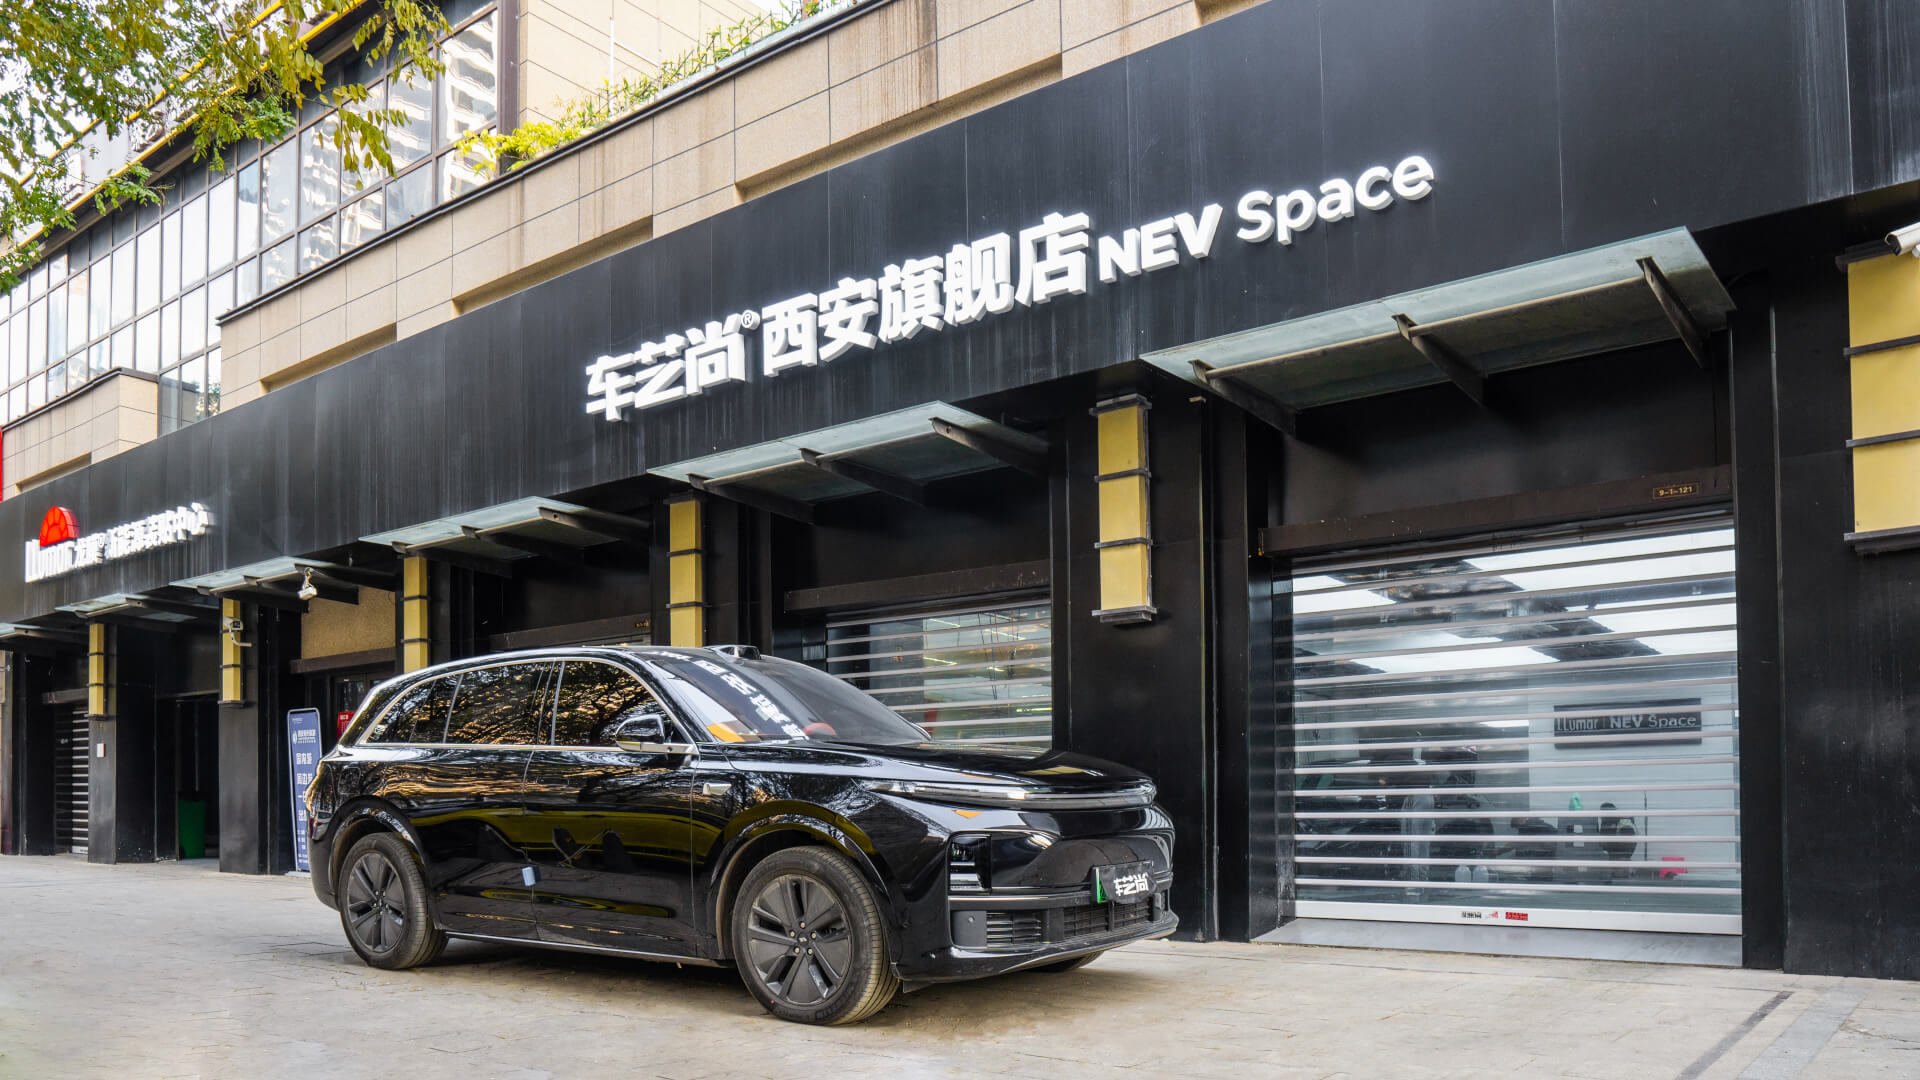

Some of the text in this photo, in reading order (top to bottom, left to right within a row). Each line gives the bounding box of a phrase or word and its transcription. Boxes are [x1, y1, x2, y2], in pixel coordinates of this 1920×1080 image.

[1098, 203, 1223, 283] NEV
[1236, 155, 1434, 246] Space
[1610, 714, 1643, 729] NEV
[1648, 714, 1697, 729] Space
[1113, 872, 1149, 896] 车艺尚
